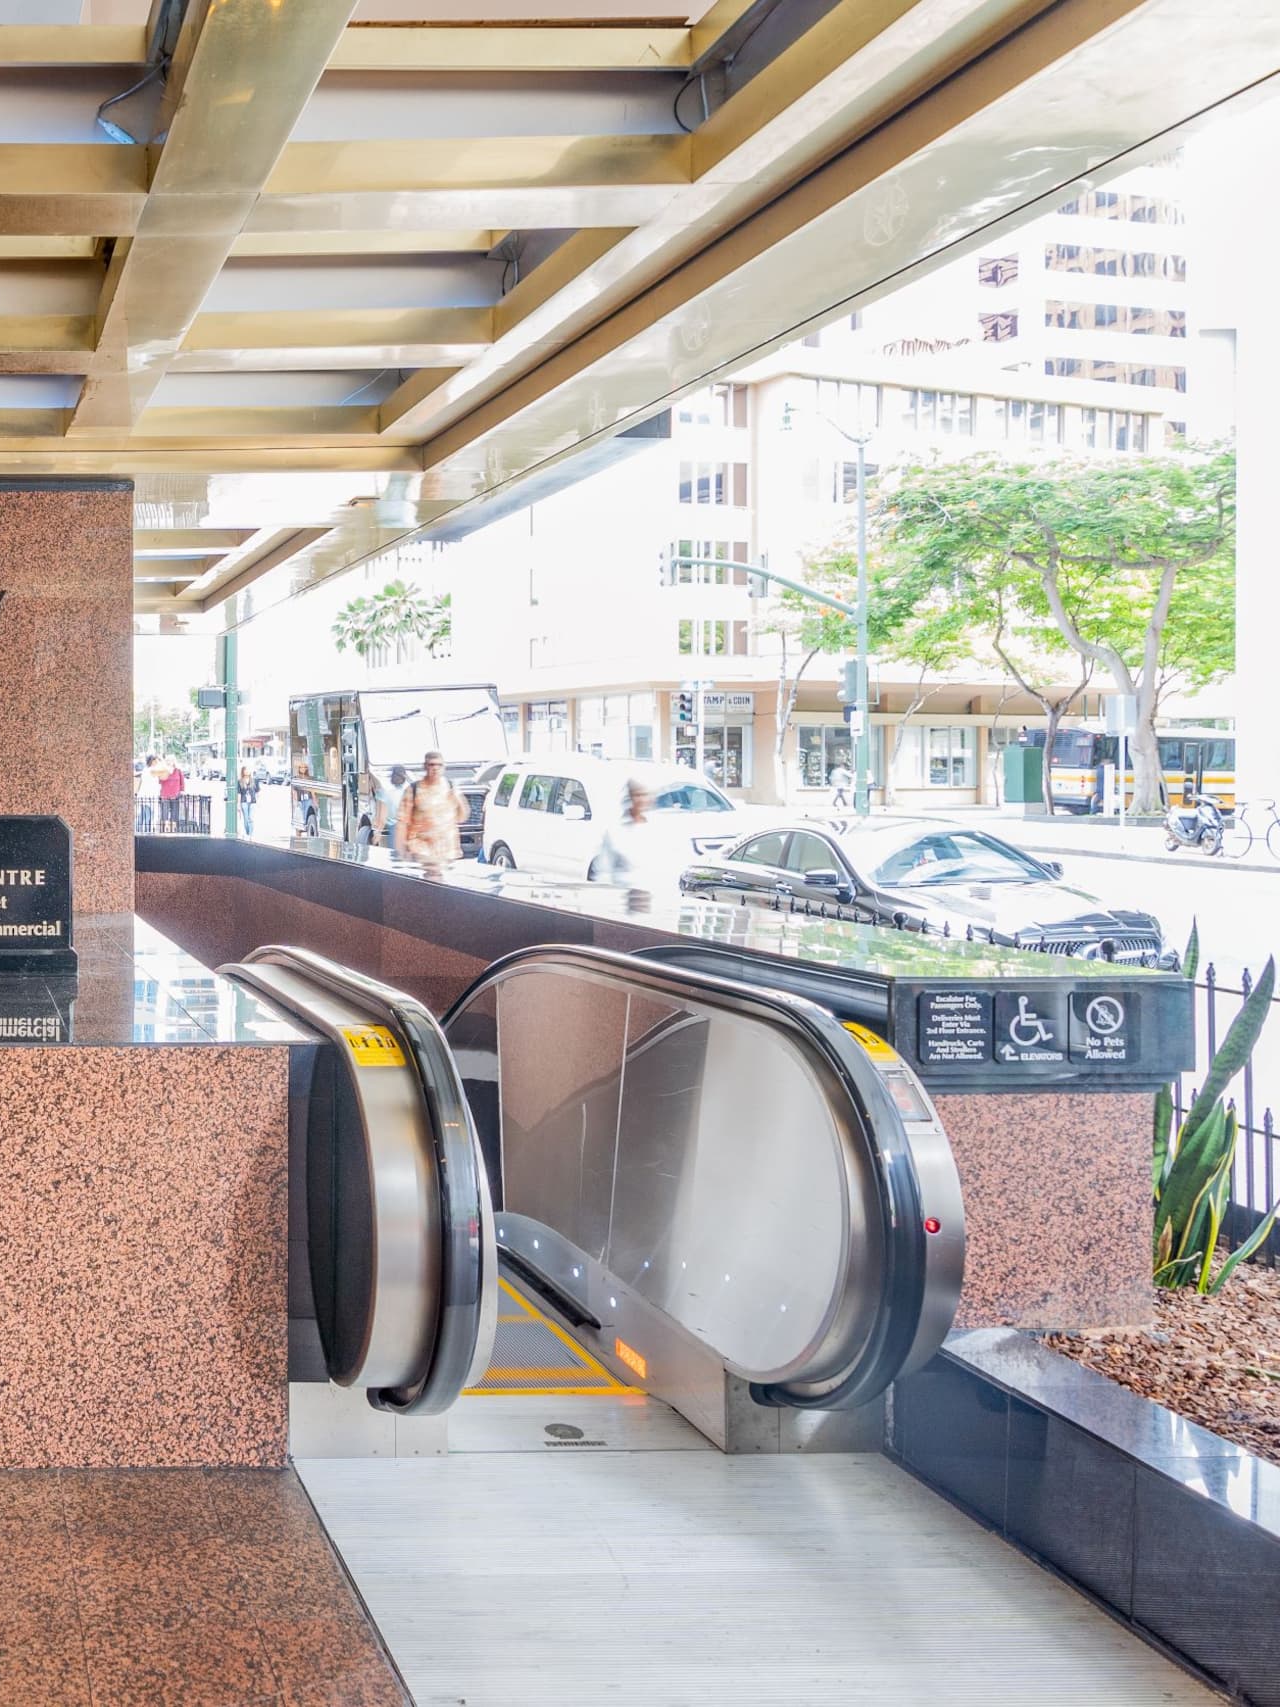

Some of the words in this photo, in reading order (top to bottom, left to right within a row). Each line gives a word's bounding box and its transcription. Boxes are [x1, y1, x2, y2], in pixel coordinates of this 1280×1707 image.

[704, 696, 724, 704] TAMP
[733, 696, 750, 704] COIN
[930, 1002, 964, 1010] Passengers
[1086, 1037, 1101, 1047] No
[1103, 1037, 1124, 1046] Pets
[1020, 1053, 1063, 1061] ELEVATORS
[1085, 1049, 1125, 1060] Allowed
